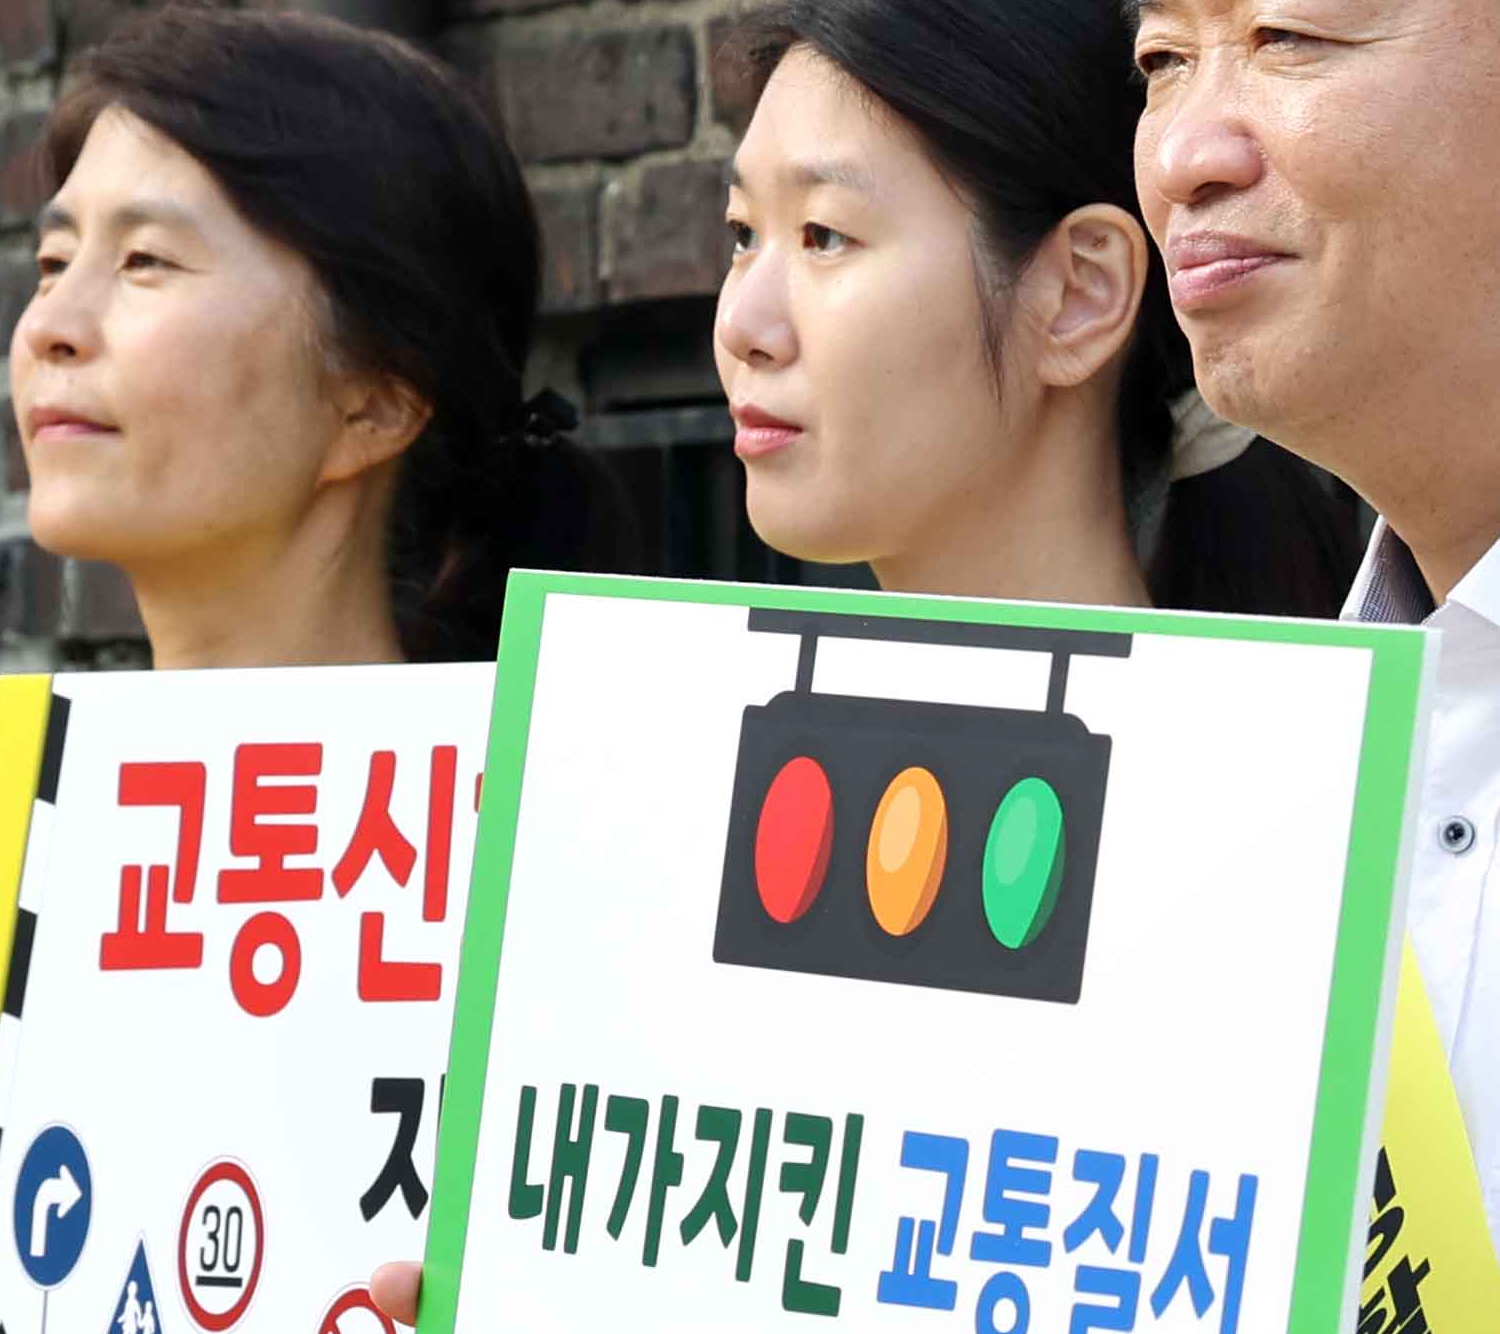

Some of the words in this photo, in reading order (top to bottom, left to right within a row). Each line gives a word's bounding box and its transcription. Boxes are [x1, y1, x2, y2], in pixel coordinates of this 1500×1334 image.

[98, 741, 485, 1018] 교통신
[199, 1204, 244, 1273] 30
[507, 1082, 864, 1318] 내가지킨
